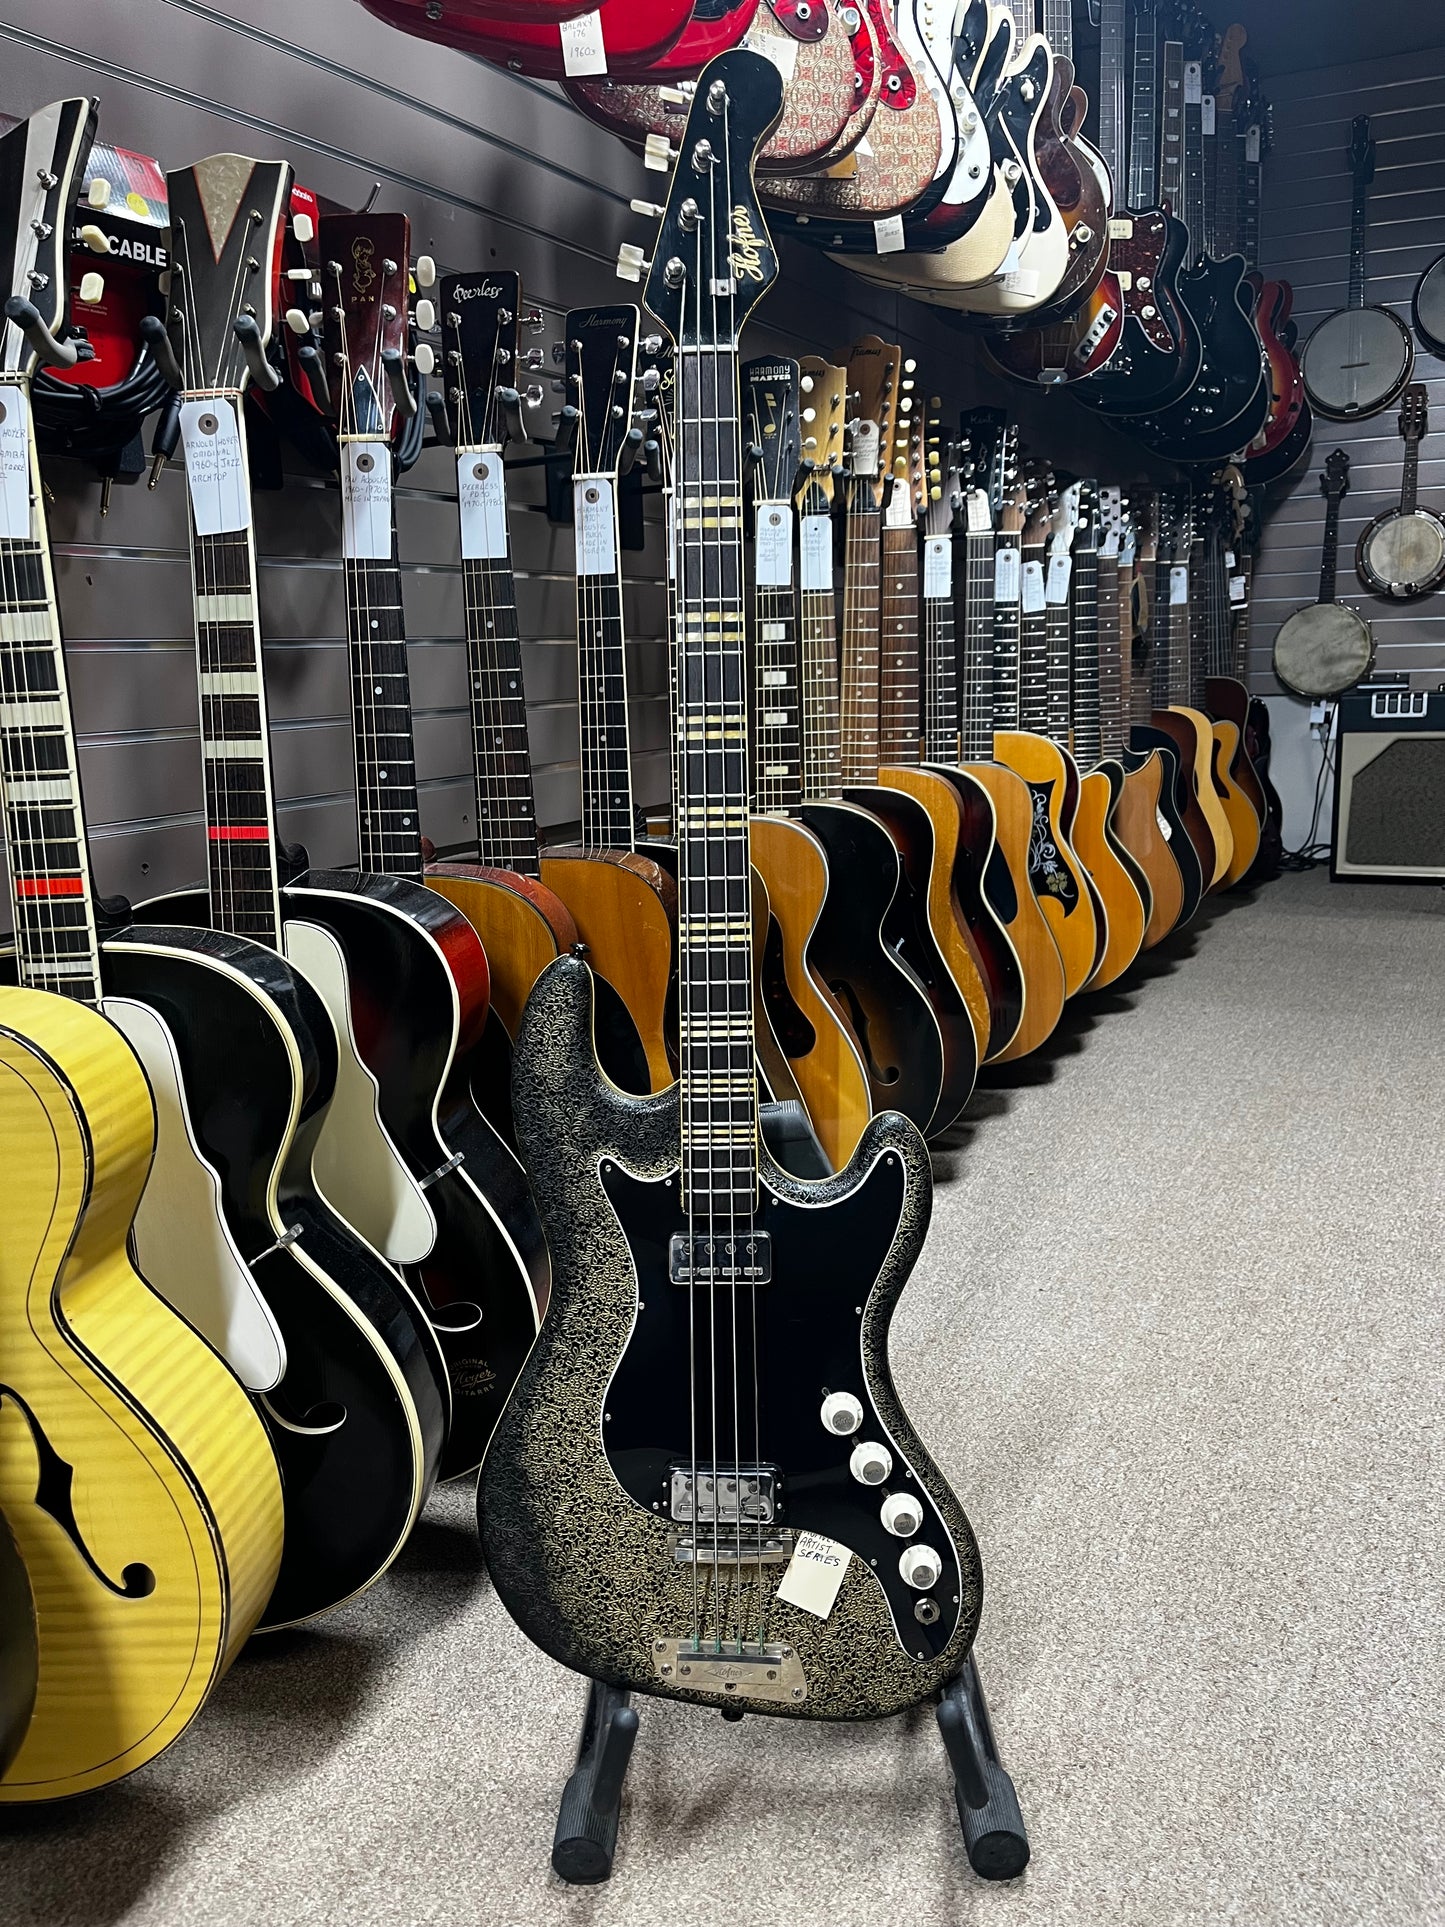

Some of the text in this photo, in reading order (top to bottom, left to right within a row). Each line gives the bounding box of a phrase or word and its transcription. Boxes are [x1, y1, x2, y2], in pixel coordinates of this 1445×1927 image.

[573, 28, 586, 38] 176
[107, 235, 167, 267] CABLE
[453, 278, 503, 303] Peerless
[578, 313, 628, 329] Harmony
[749, 365, 791, 376] HARMONY
[749, 373, 791, 382] MASTER
[186, 440, 213, 449] ARNOLD
[220, 458, 241, 468] JAZZ
[462, 482, 499, 491] PEERLESS
[453, 1383, 495, 1396] GITARRE
[800, 1536, 833, 1554] ARTIST
[797, 1548, 841, 1567] SERIES
